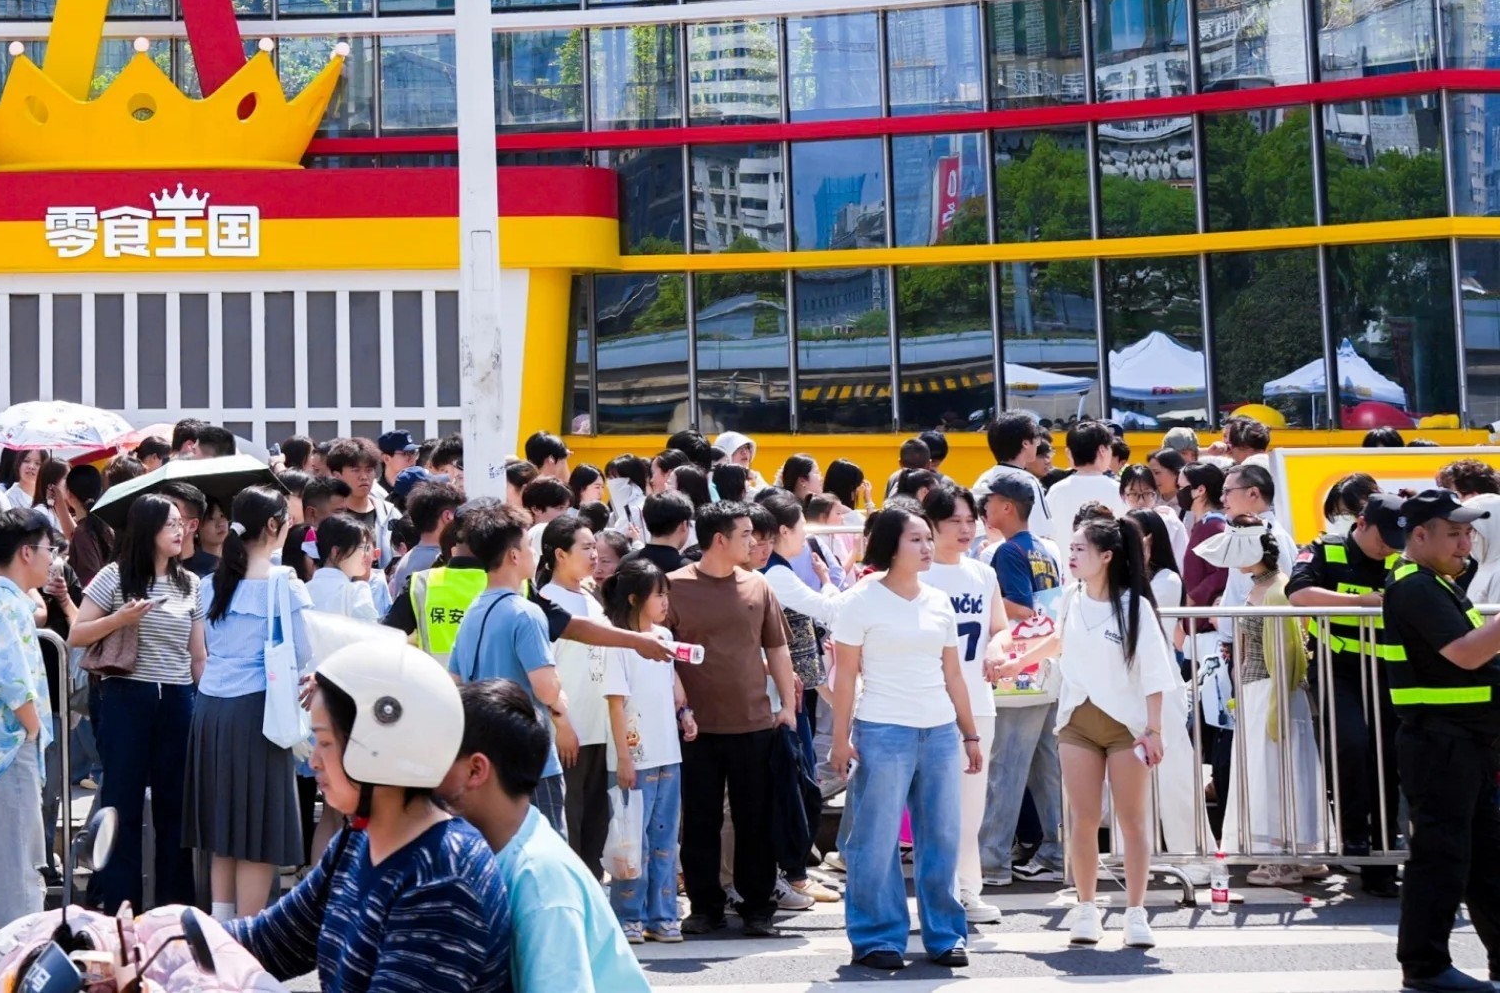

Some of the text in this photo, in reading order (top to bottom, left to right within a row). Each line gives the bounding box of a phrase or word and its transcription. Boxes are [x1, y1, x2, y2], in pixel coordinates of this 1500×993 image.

[45, 205, 260, 258] 零食王国
[430, 607, 464, 625] 保安
